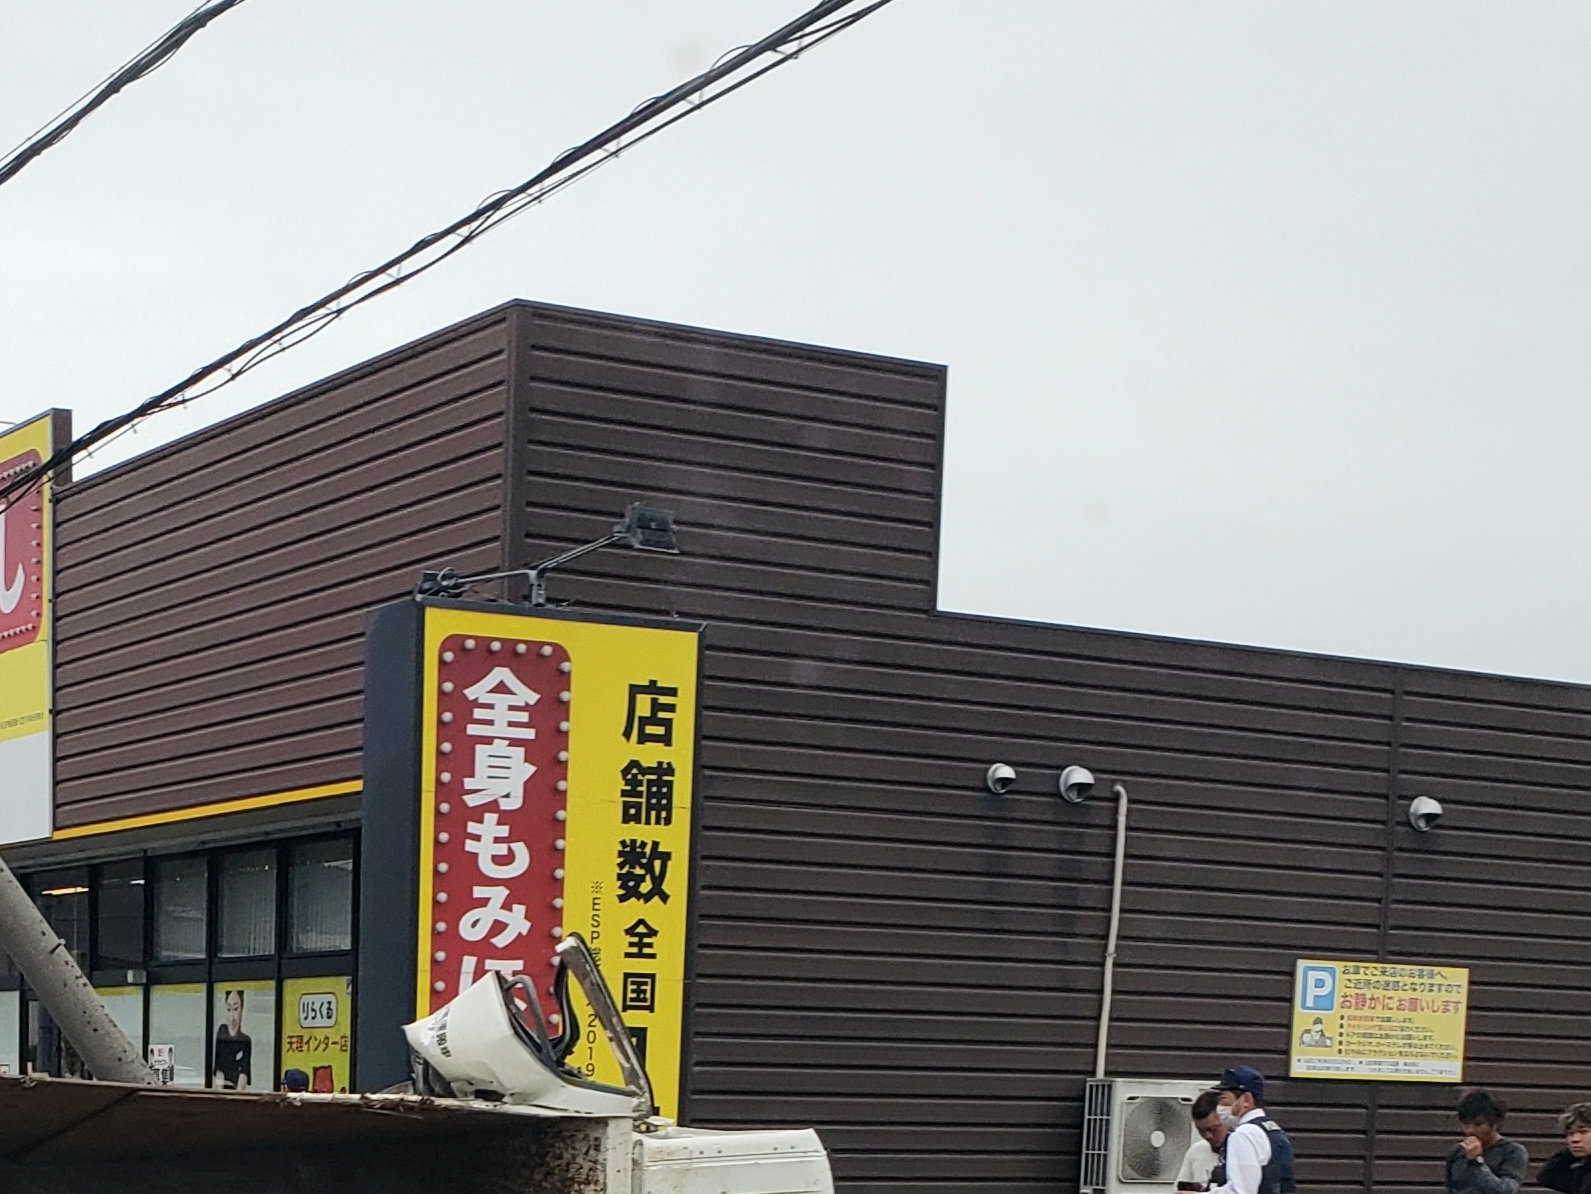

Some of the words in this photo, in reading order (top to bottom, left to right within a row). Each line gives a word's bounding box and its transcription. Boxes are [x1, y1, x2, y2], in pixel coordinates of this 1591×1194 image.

[301, 1000, 334, 1021] りらくる
[585, 1000, 598, 1077] 2019
